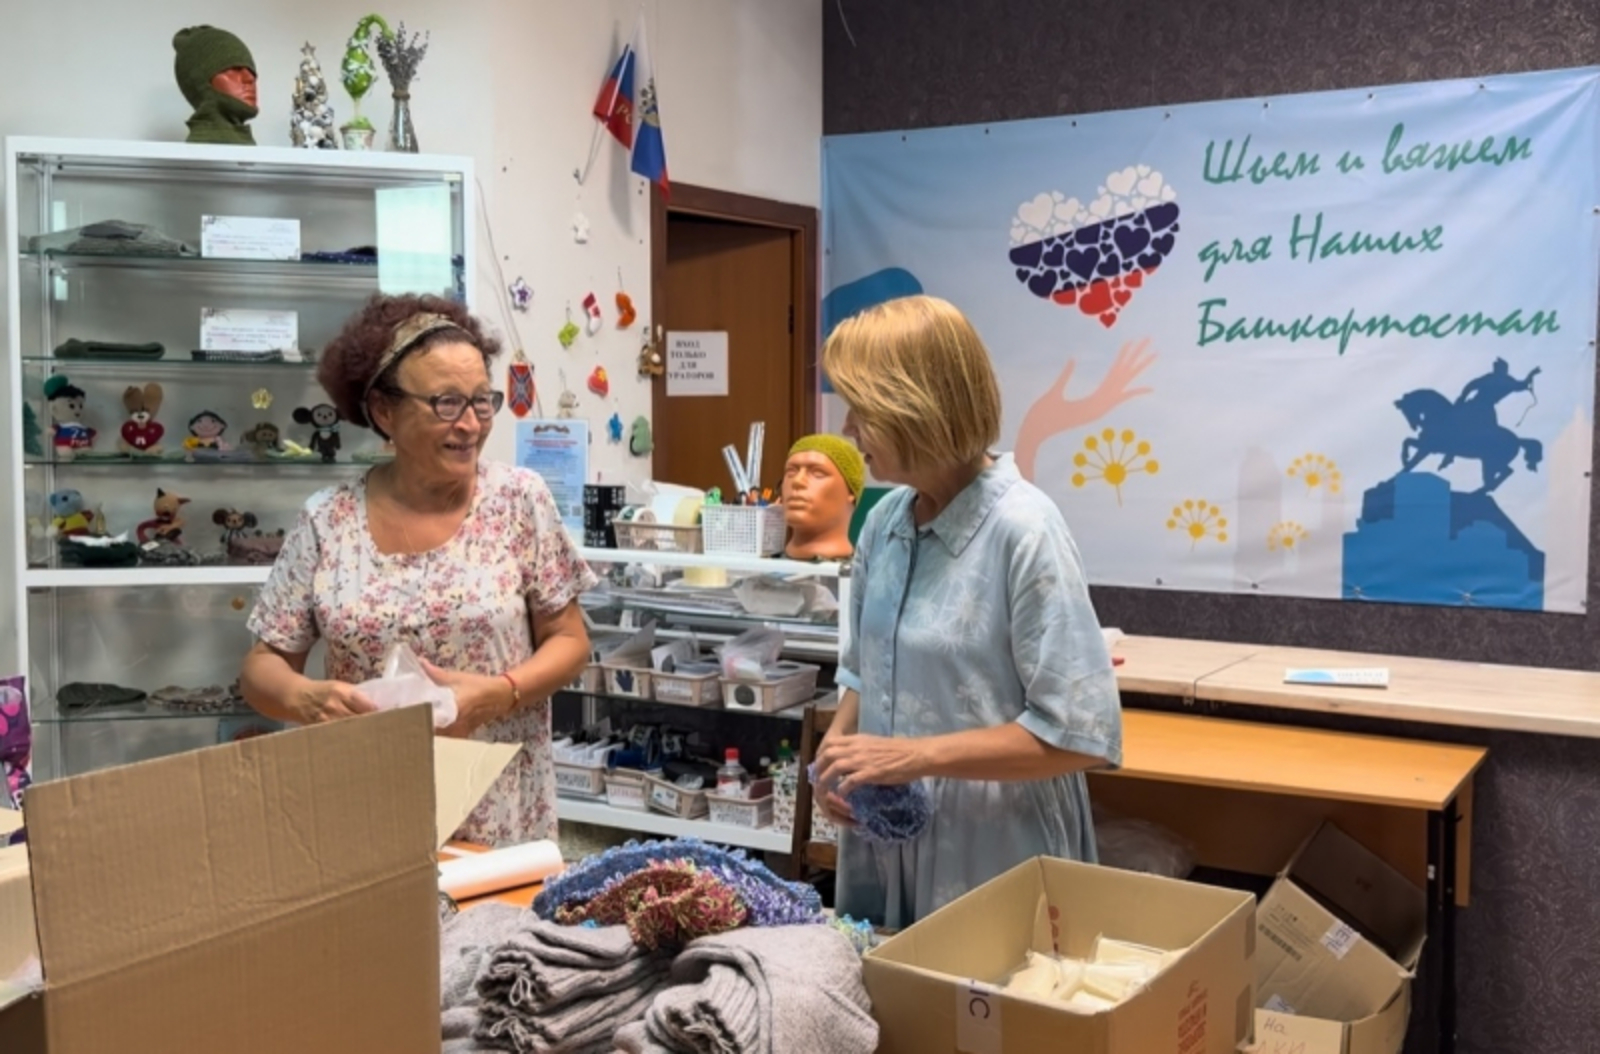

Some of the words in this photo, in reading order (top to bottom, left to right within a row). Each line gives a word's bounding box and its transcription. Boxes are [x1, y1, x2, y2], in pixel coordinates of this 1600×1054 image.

[1203, 134, 1321, 184] Шьем
[1336, 150, 1365, 174] и
[1382, 122, 1533, 175] вяжем
[1198, 234, 1272, 283] для
[1289, 212, 1443, 263] Наших
[1197, 298, 1560, 356] Башкортостан
[671, 351, 707, 359] ТОЛЬКО
[676, 340, 700, 349] ВХОД
[678, 361, 697, 370] ДЛЯ
